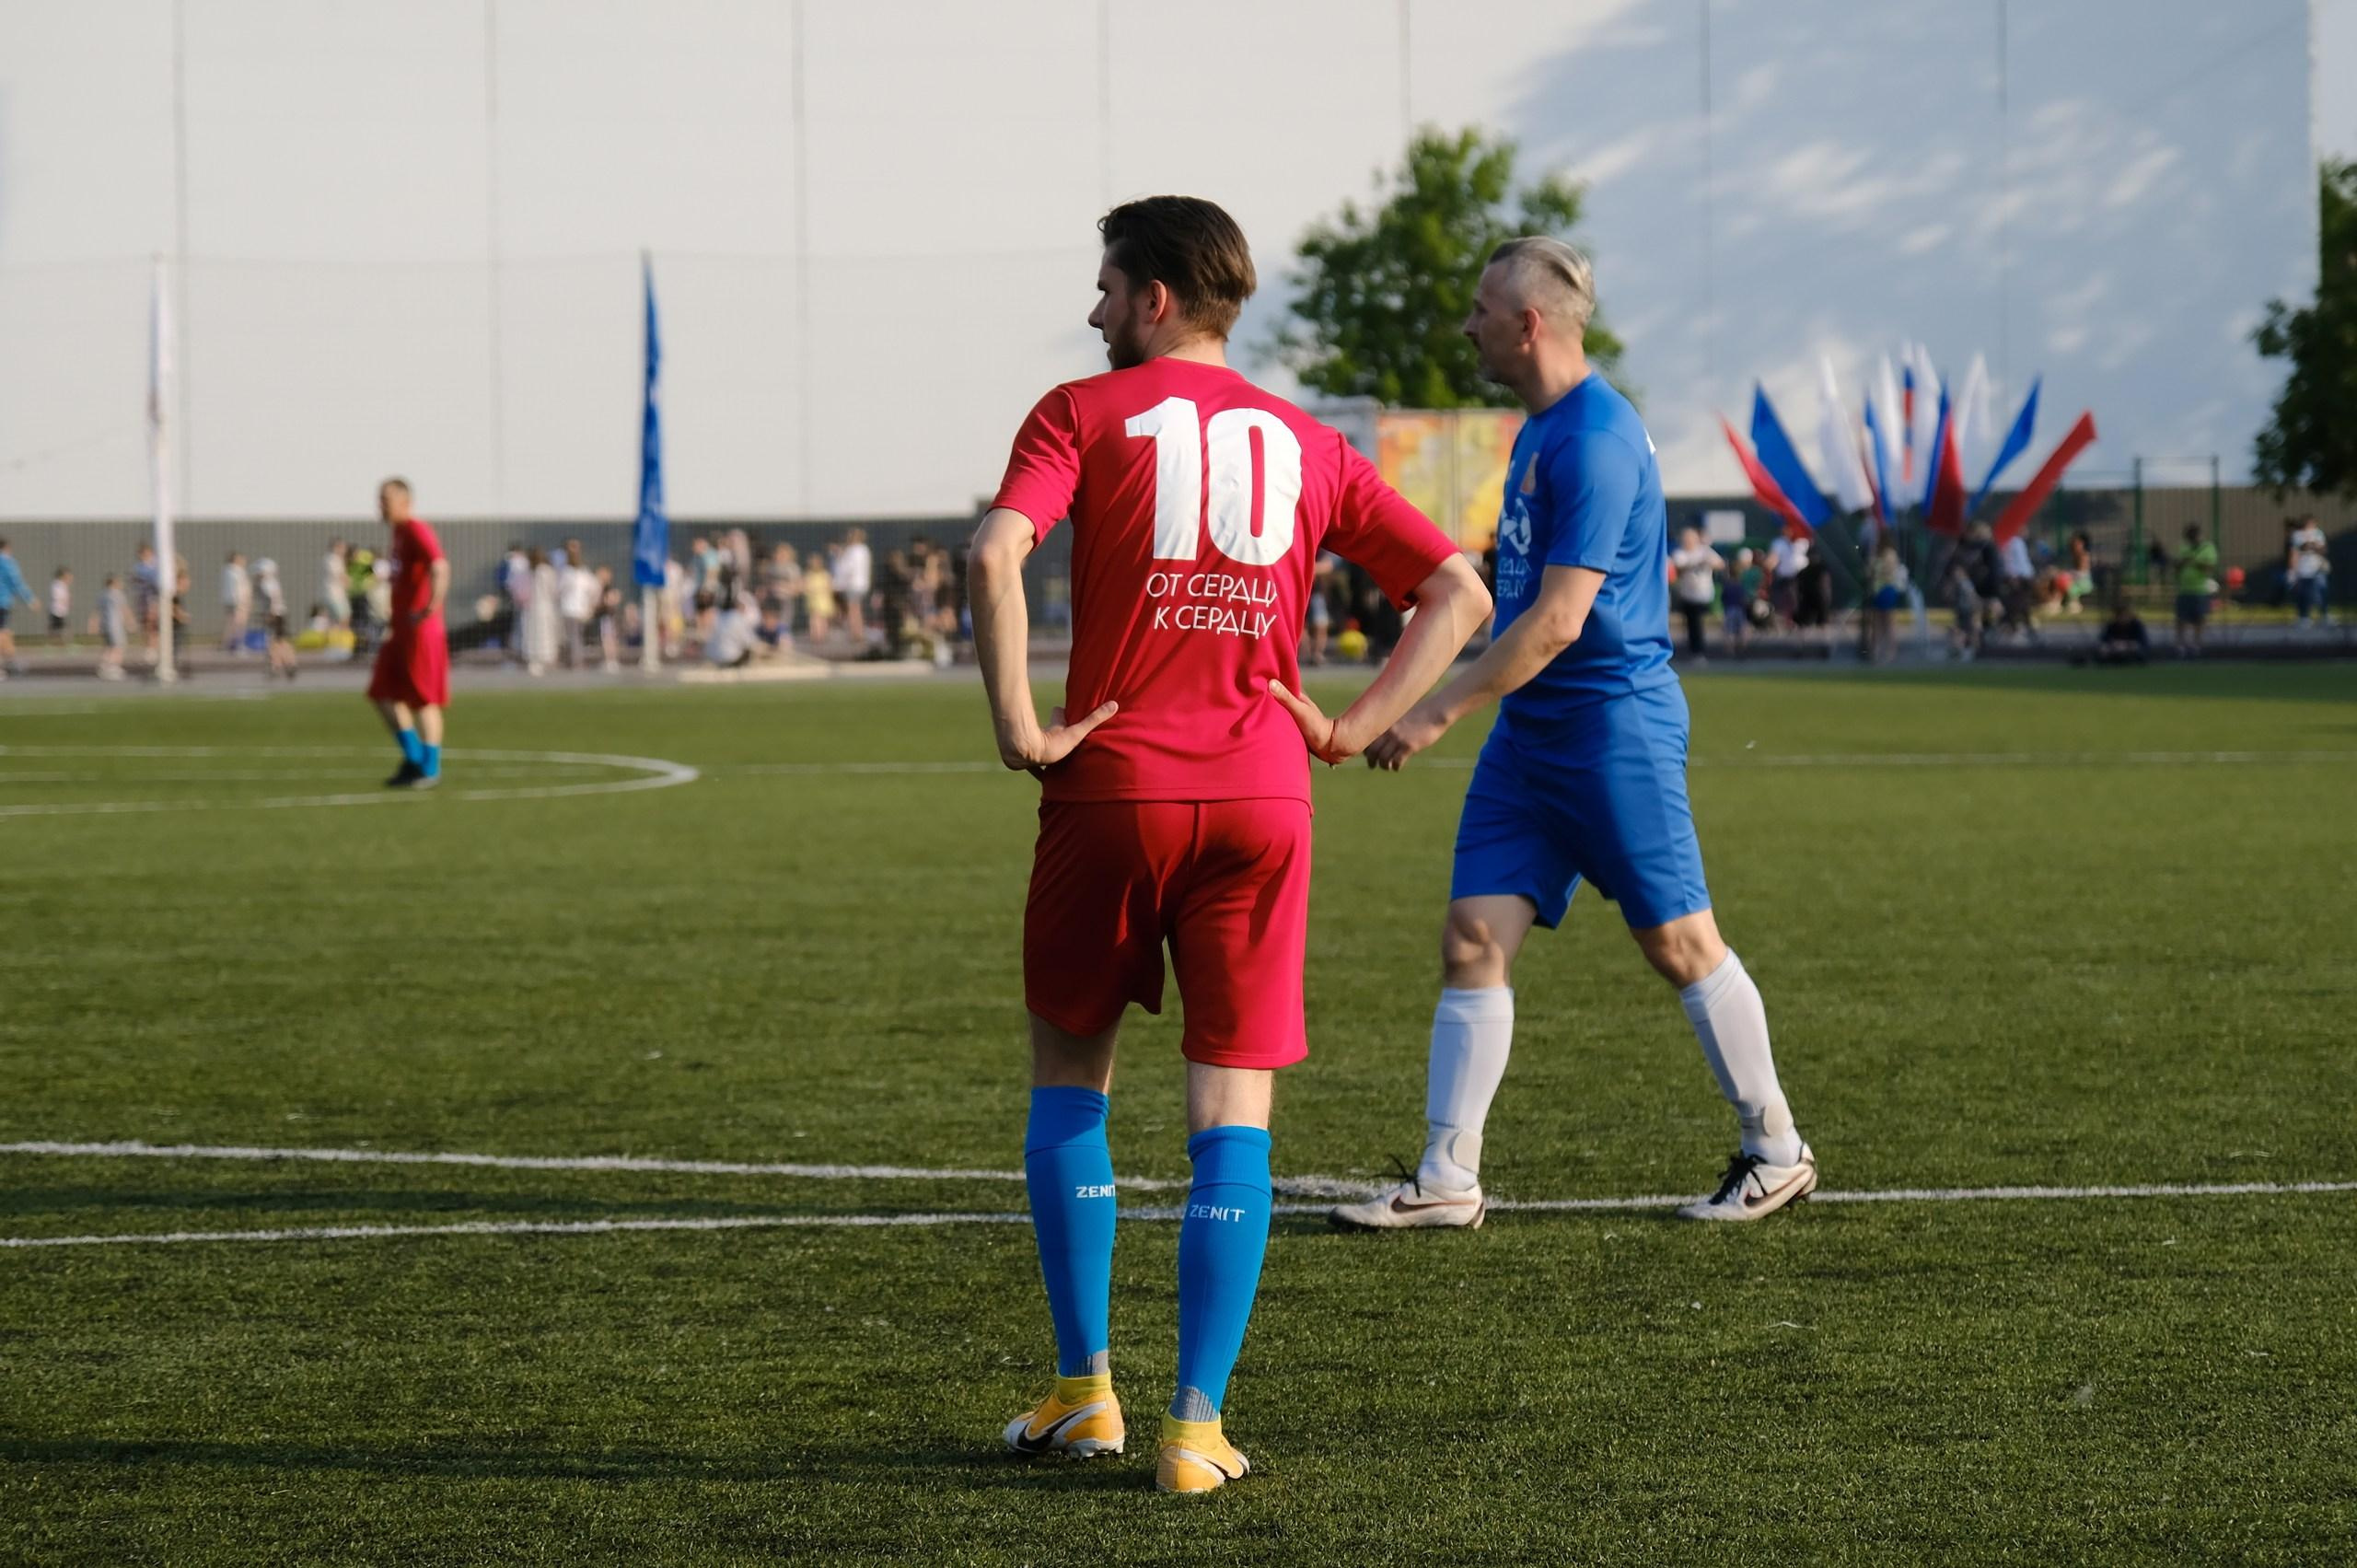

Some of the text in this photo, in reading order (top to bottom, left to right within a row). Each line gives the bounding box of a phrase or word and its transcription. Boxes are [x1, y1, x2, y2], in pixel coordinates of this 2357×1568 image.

[1125, 396, 1303, 566] 10
[1146, 573, 1184, 598] ОТ
[1154, 605, 1277, 640] К СЕРДЦУ
[1190, 1204, 1246, 1223] ZENIT
